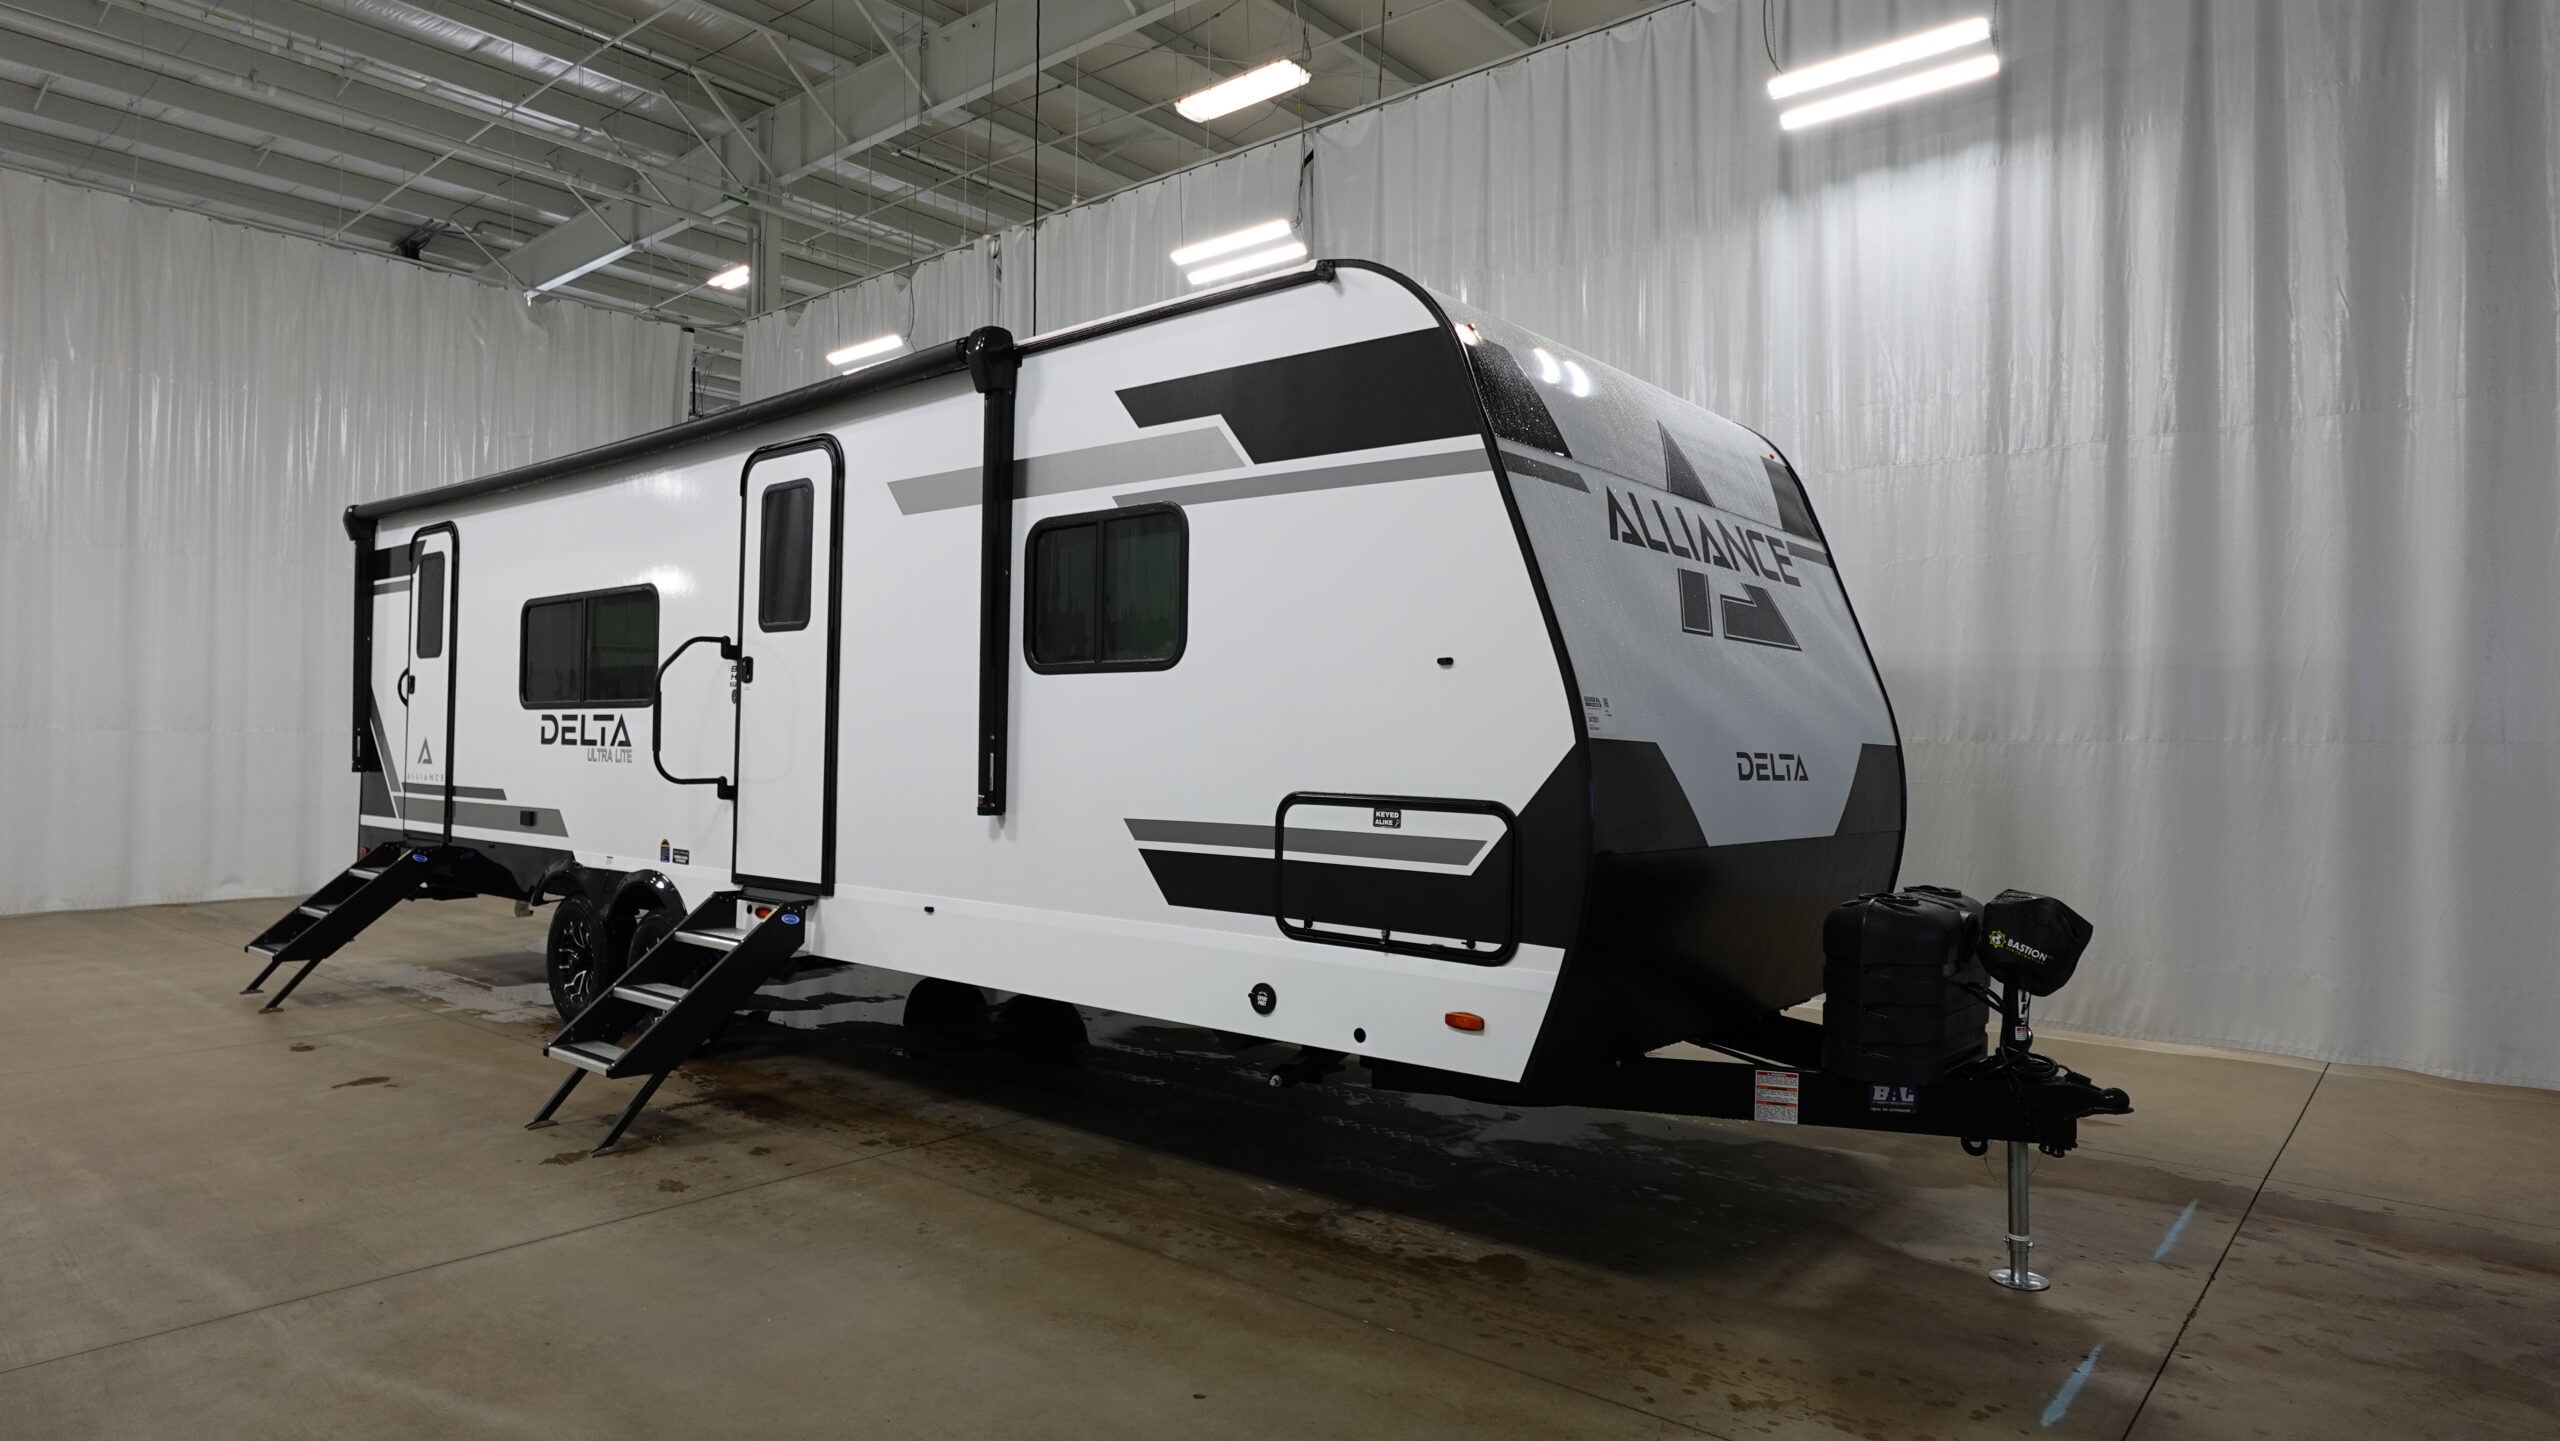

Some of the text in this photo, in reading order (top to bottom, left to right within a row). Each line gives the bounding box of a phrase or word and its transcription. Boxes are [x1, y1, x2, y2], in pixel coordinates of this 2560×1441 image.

[1606, 485, 1802, 588] ALLIANCE
[540, 713, 632, 747] DELTA
[587, 748, 632, 763] ULTRA LITE
[1736, 751, 1809, 781] DELTA
[407, 771, 444, 782] ALLIANCE
[1376, 811, 1400, 819] KEYED
[2007, 938, 2048, 962] BASTION
